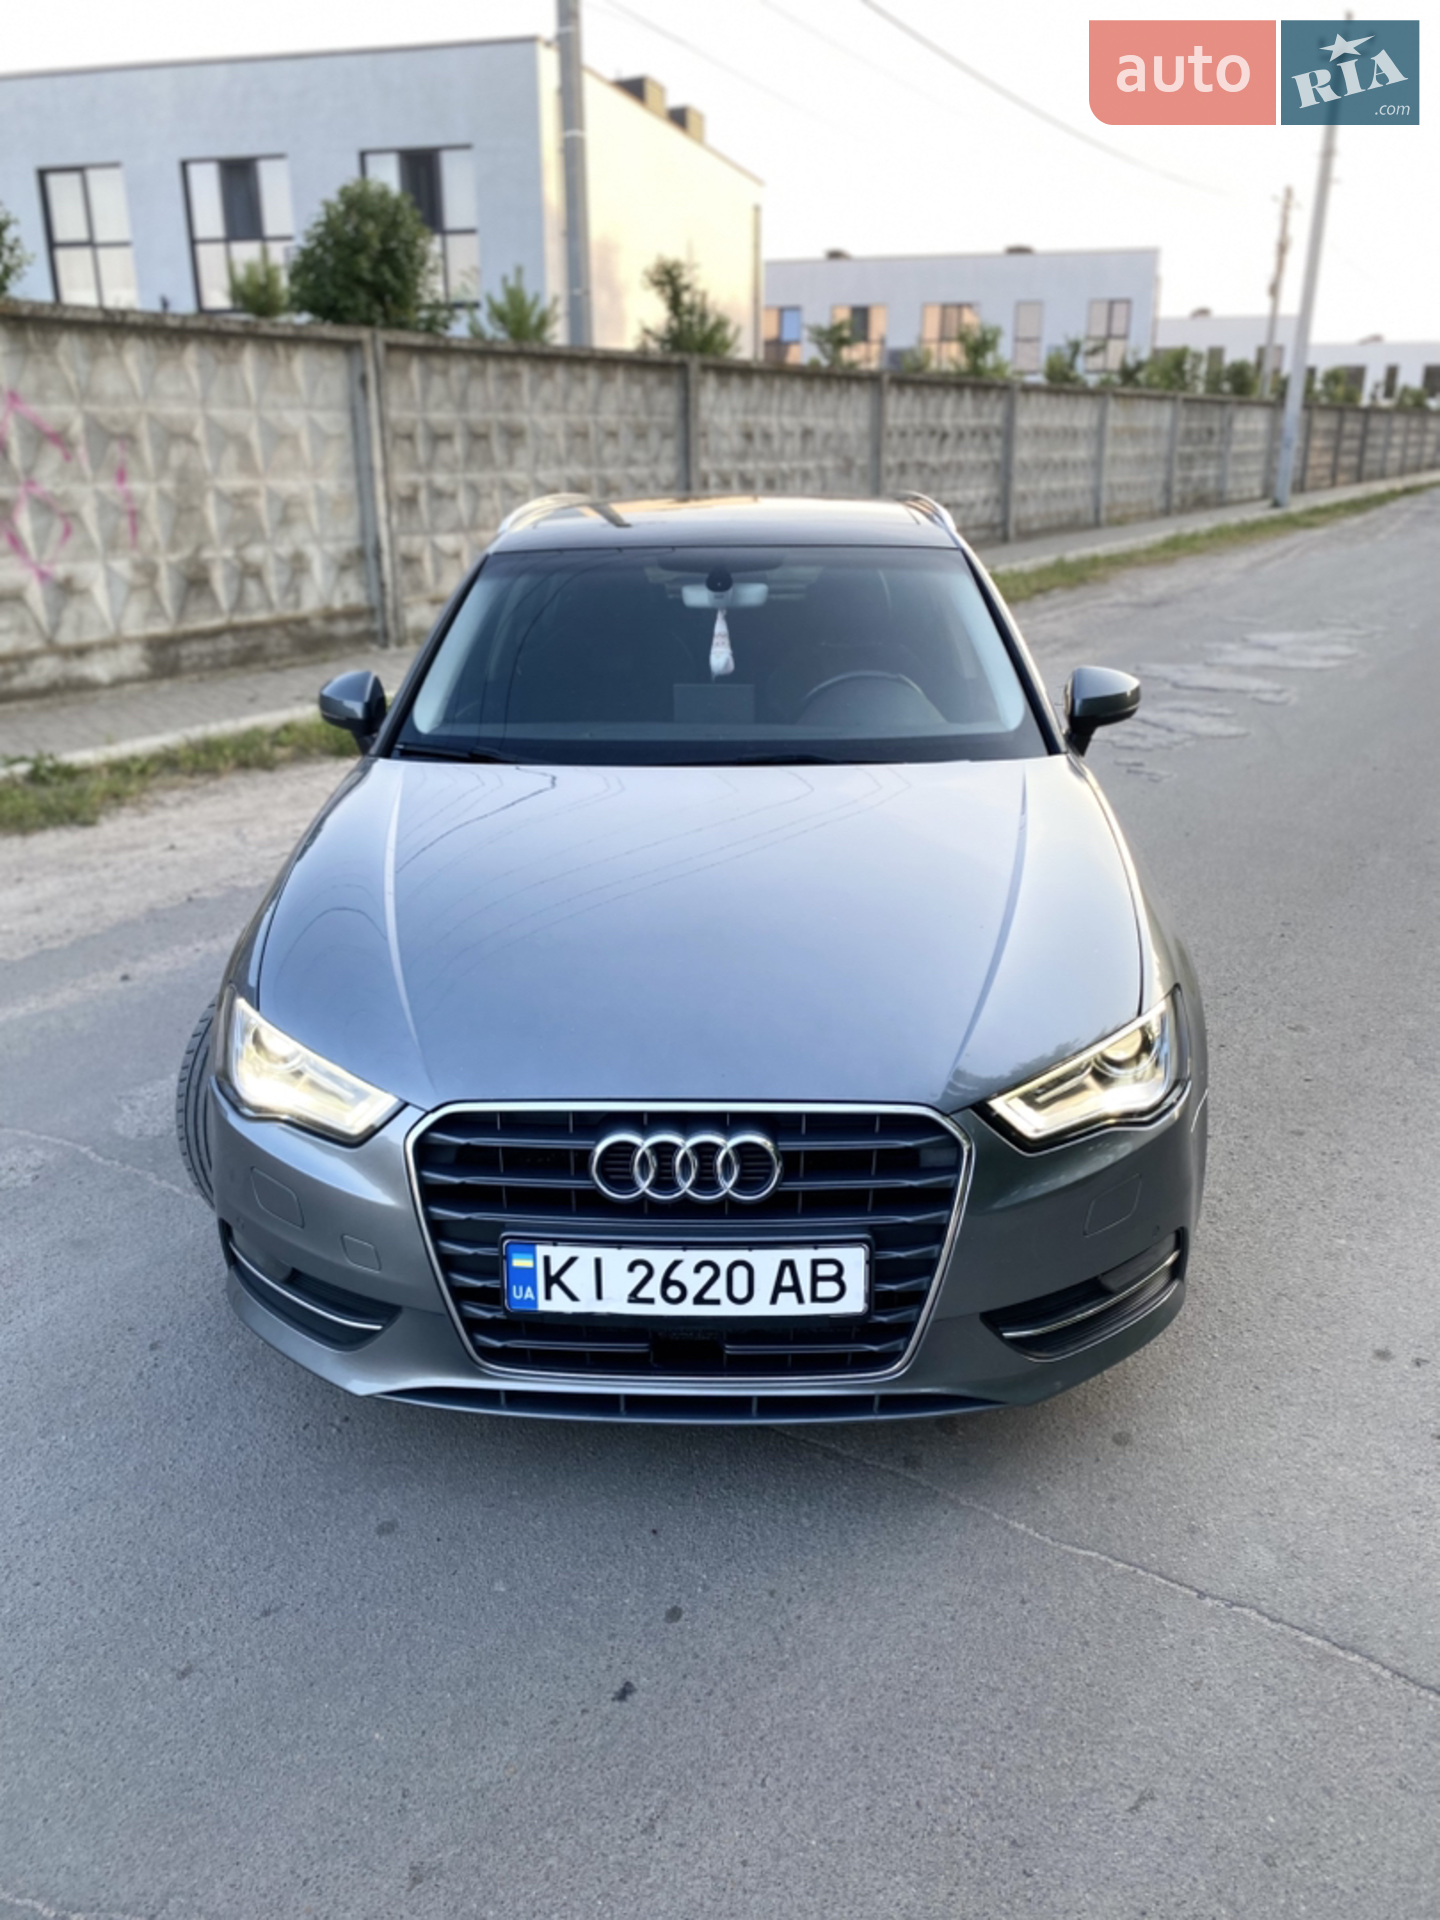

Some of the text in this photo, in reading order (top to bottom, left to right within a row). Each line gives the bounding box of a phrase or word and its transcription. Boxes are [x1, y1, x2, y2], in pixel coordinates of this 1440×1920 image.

[512, 1285, 535, 1301] UA
[543, 1254, 847, 1306] KI 2620 AB
